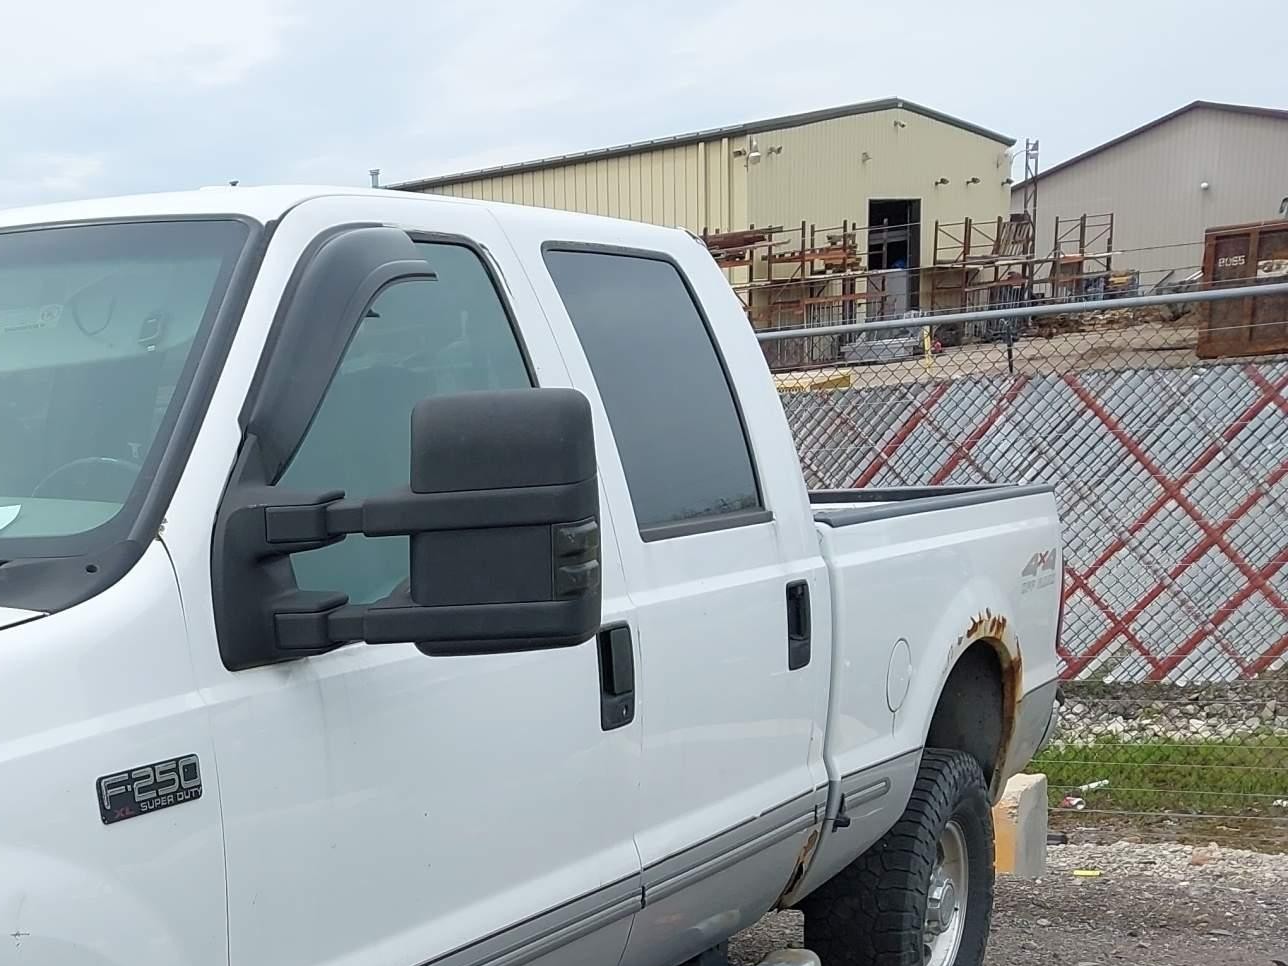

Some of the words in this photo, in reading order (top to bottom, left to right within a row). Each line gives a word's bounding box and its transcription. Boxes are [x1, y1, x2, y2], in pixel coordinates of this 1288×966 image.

[100, 756, 202, 810] F-250
[140, 794, 174, 811] SUPER
[176, 786, 202, 801] DUTY
